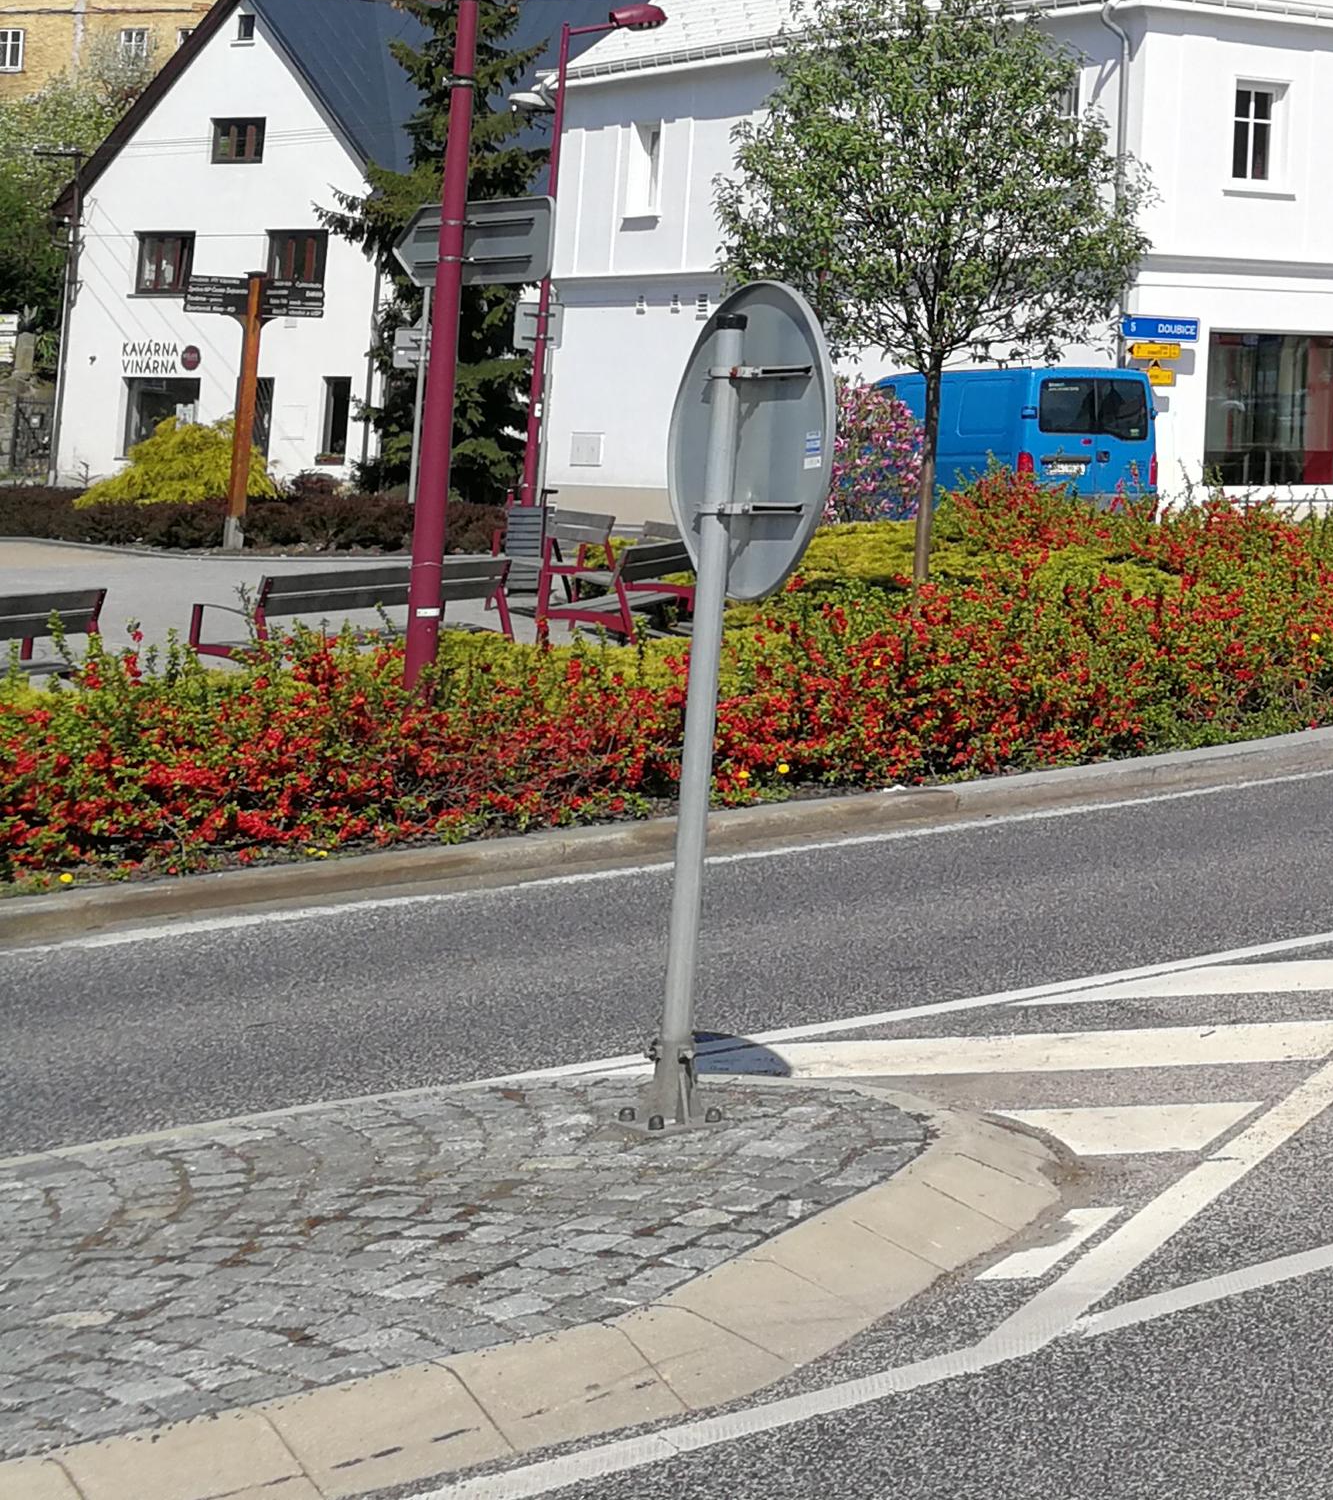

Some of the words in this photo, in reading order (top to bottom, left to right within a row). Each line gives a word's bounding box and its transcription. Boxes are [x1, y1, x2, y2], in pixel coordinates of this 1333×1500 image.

[1158, 323, 1196, 335] DOUBICE
[122, 339, 179, 357] KAVÁRNA
[122, 356, 177, 374] VINÁRNA
